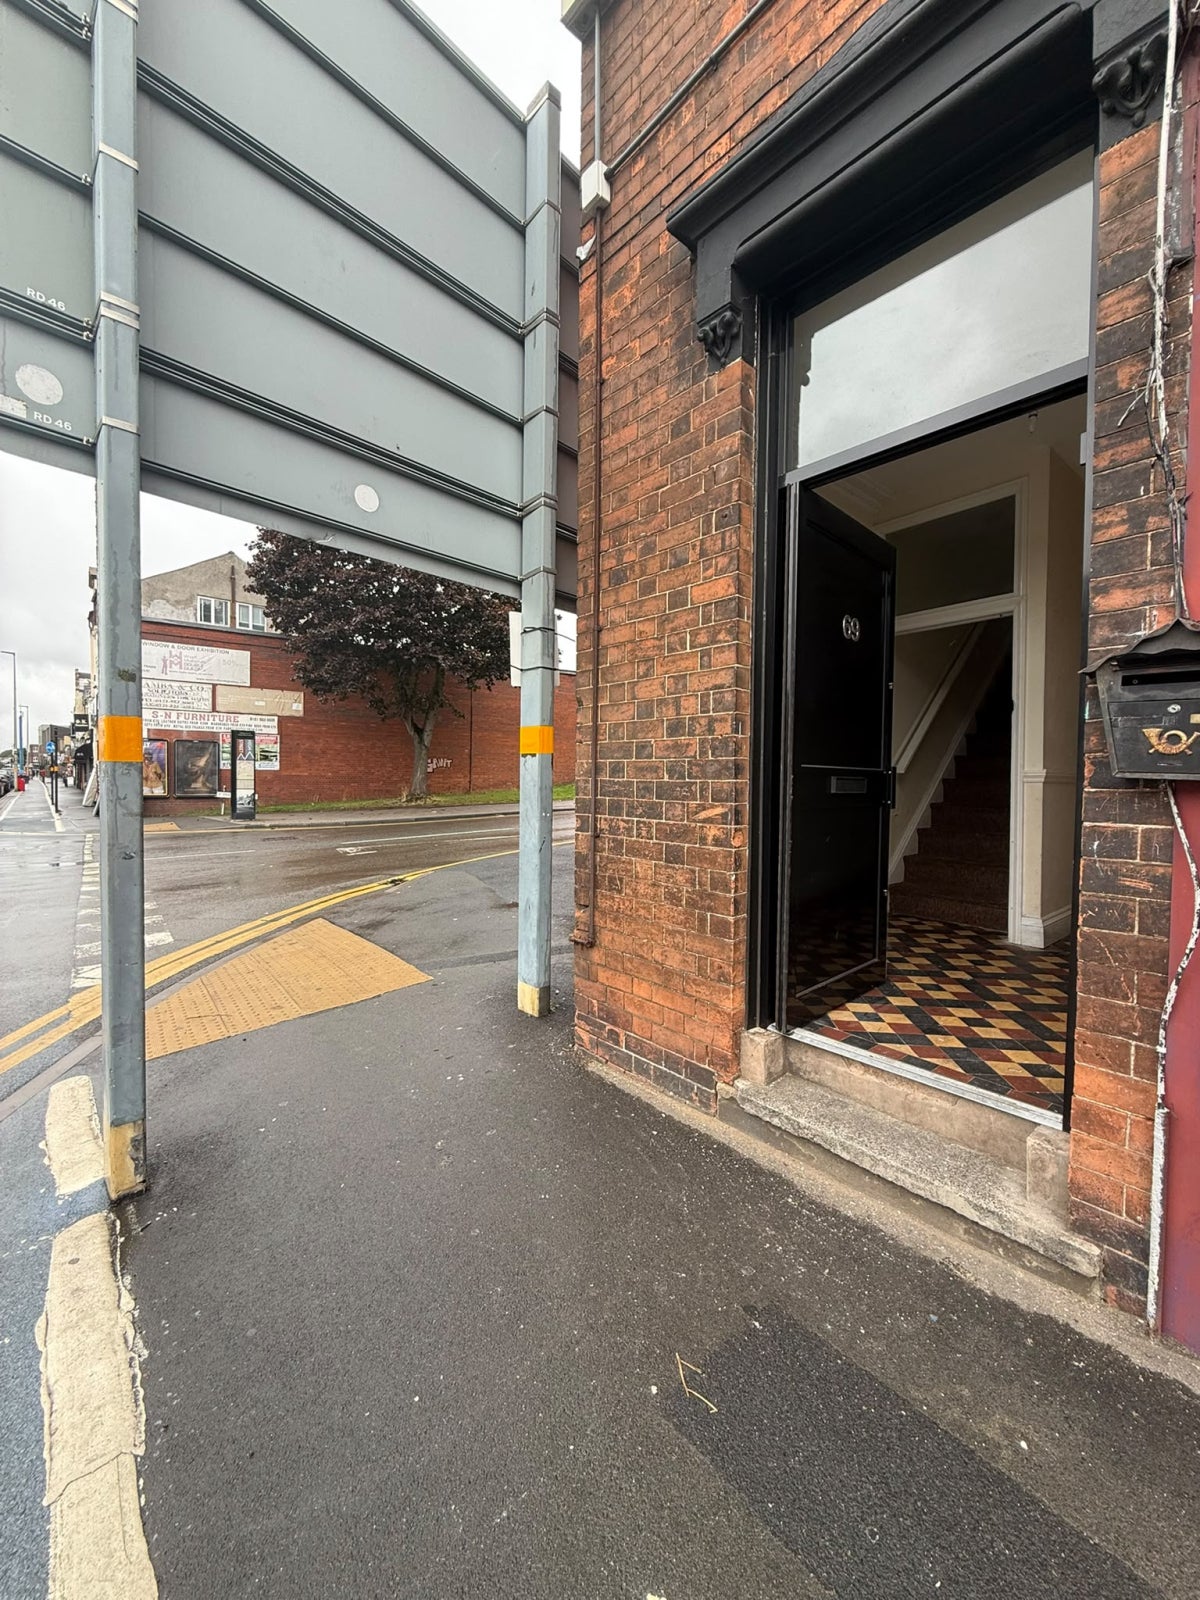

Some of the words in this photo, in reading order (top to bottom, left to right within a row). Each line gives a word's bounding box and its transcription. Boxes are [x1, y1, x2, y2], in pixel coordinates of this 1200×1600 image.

[26, 287, 46, 302] RD
[47, 297, 66, 311] 46
[33, 411, 53, 425] RD
[54, 419, 72, 431] 46
[842, 614, 859, 642] 69
[142, 641, 170, 649] WINDOW
[196, 647, 230, 655] EXHIBITION
[151, 711, 172, 719] S-N
[176, 712, 240, 722] FURNITURE
